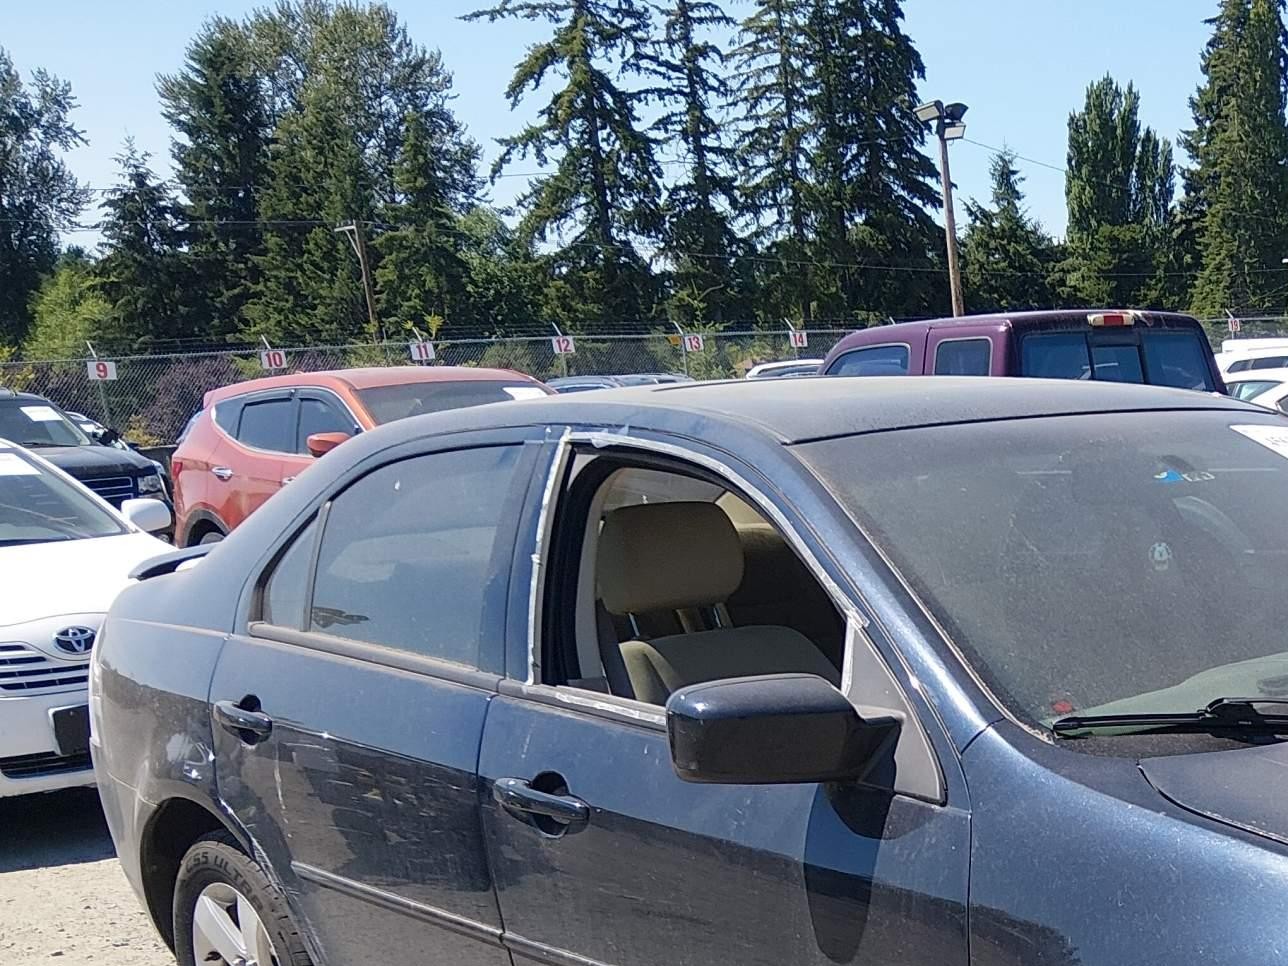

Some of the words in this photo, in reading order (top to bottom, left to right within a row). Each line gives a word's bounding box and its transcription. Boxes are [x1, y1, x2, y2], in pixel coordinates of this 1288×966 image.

[1230, 320, 1239, 331] 19
[556, 338, 571, 352] 12
[687, 336, 701, 351] 13
[793, 331, 804, 346] 14
[416, 343, 430, 358] 11
[265, 351, 283, 368] 10
[95, 362, 108, 379] 9
